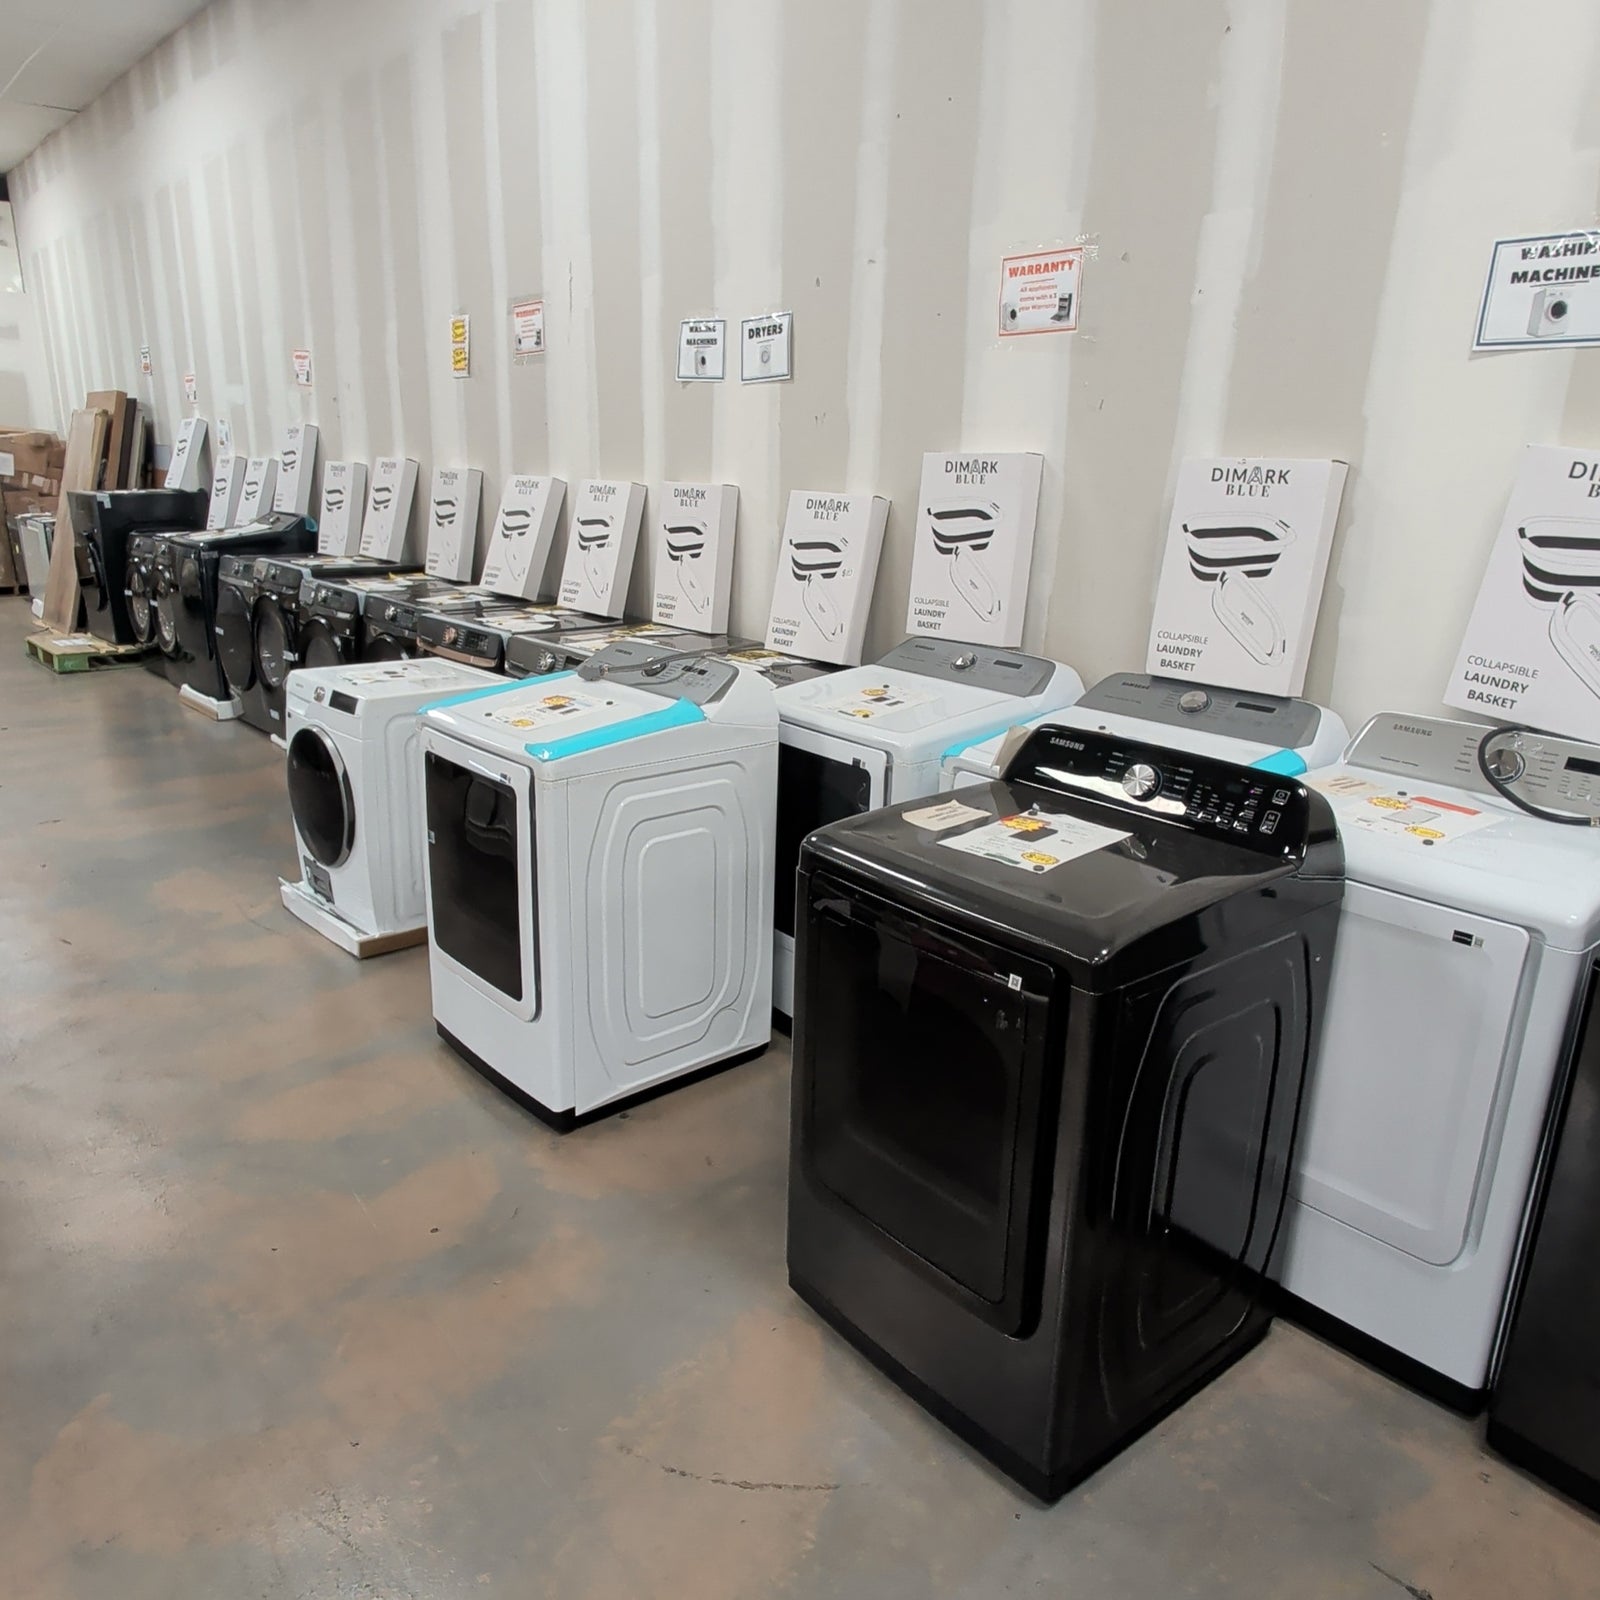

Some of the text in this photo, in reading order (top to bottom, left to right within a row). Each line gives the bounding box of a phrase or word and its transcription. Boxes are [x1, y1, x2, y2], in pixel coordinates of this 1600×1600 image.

[1520, 241, 1600, 260] WASHIN
[1008, 259, 1074, 279] WARRANTY
[1510, 265, 1600, 284] MACHINE
[748, 323, 783, 340] DRYERS
[945, 459, 1000, 475] DIMARK
[1568, 461, 1600, 481] DI
[955, 474, 987, 485] BLUE
[1211, 466, 1291, 485] DIMARK
[674, 488, 707, 500] DIMARK
[1226, 484, 1271, 498] BLUE
[806, 498, 850, 513] DIMARK
[814, 511, 839, 522] BLUE
[914, 608, 946, 619] LAUNDRY
[772, 627, 797, 637] LAUNDRY
[917, 620, 941, 631] BASKET
[773, 637, 793, 648] BASKET
[1157, 630, 1208, 645] COLLAPSIBLE
[1156, 643, 1203, 658] LAUNDRY
[1160, 659, 1196, 672] BASKET
[1467, 655, 1540, 679] COLLAPSIBLE
[1464, 671, 1529, 694] LAUNDRY
[1467, 689, 1517, 710] BASKET
[1393, 723, 1433, 737] SAMSUNG
[1050, 737, 1085, 751] SAMSUNG
